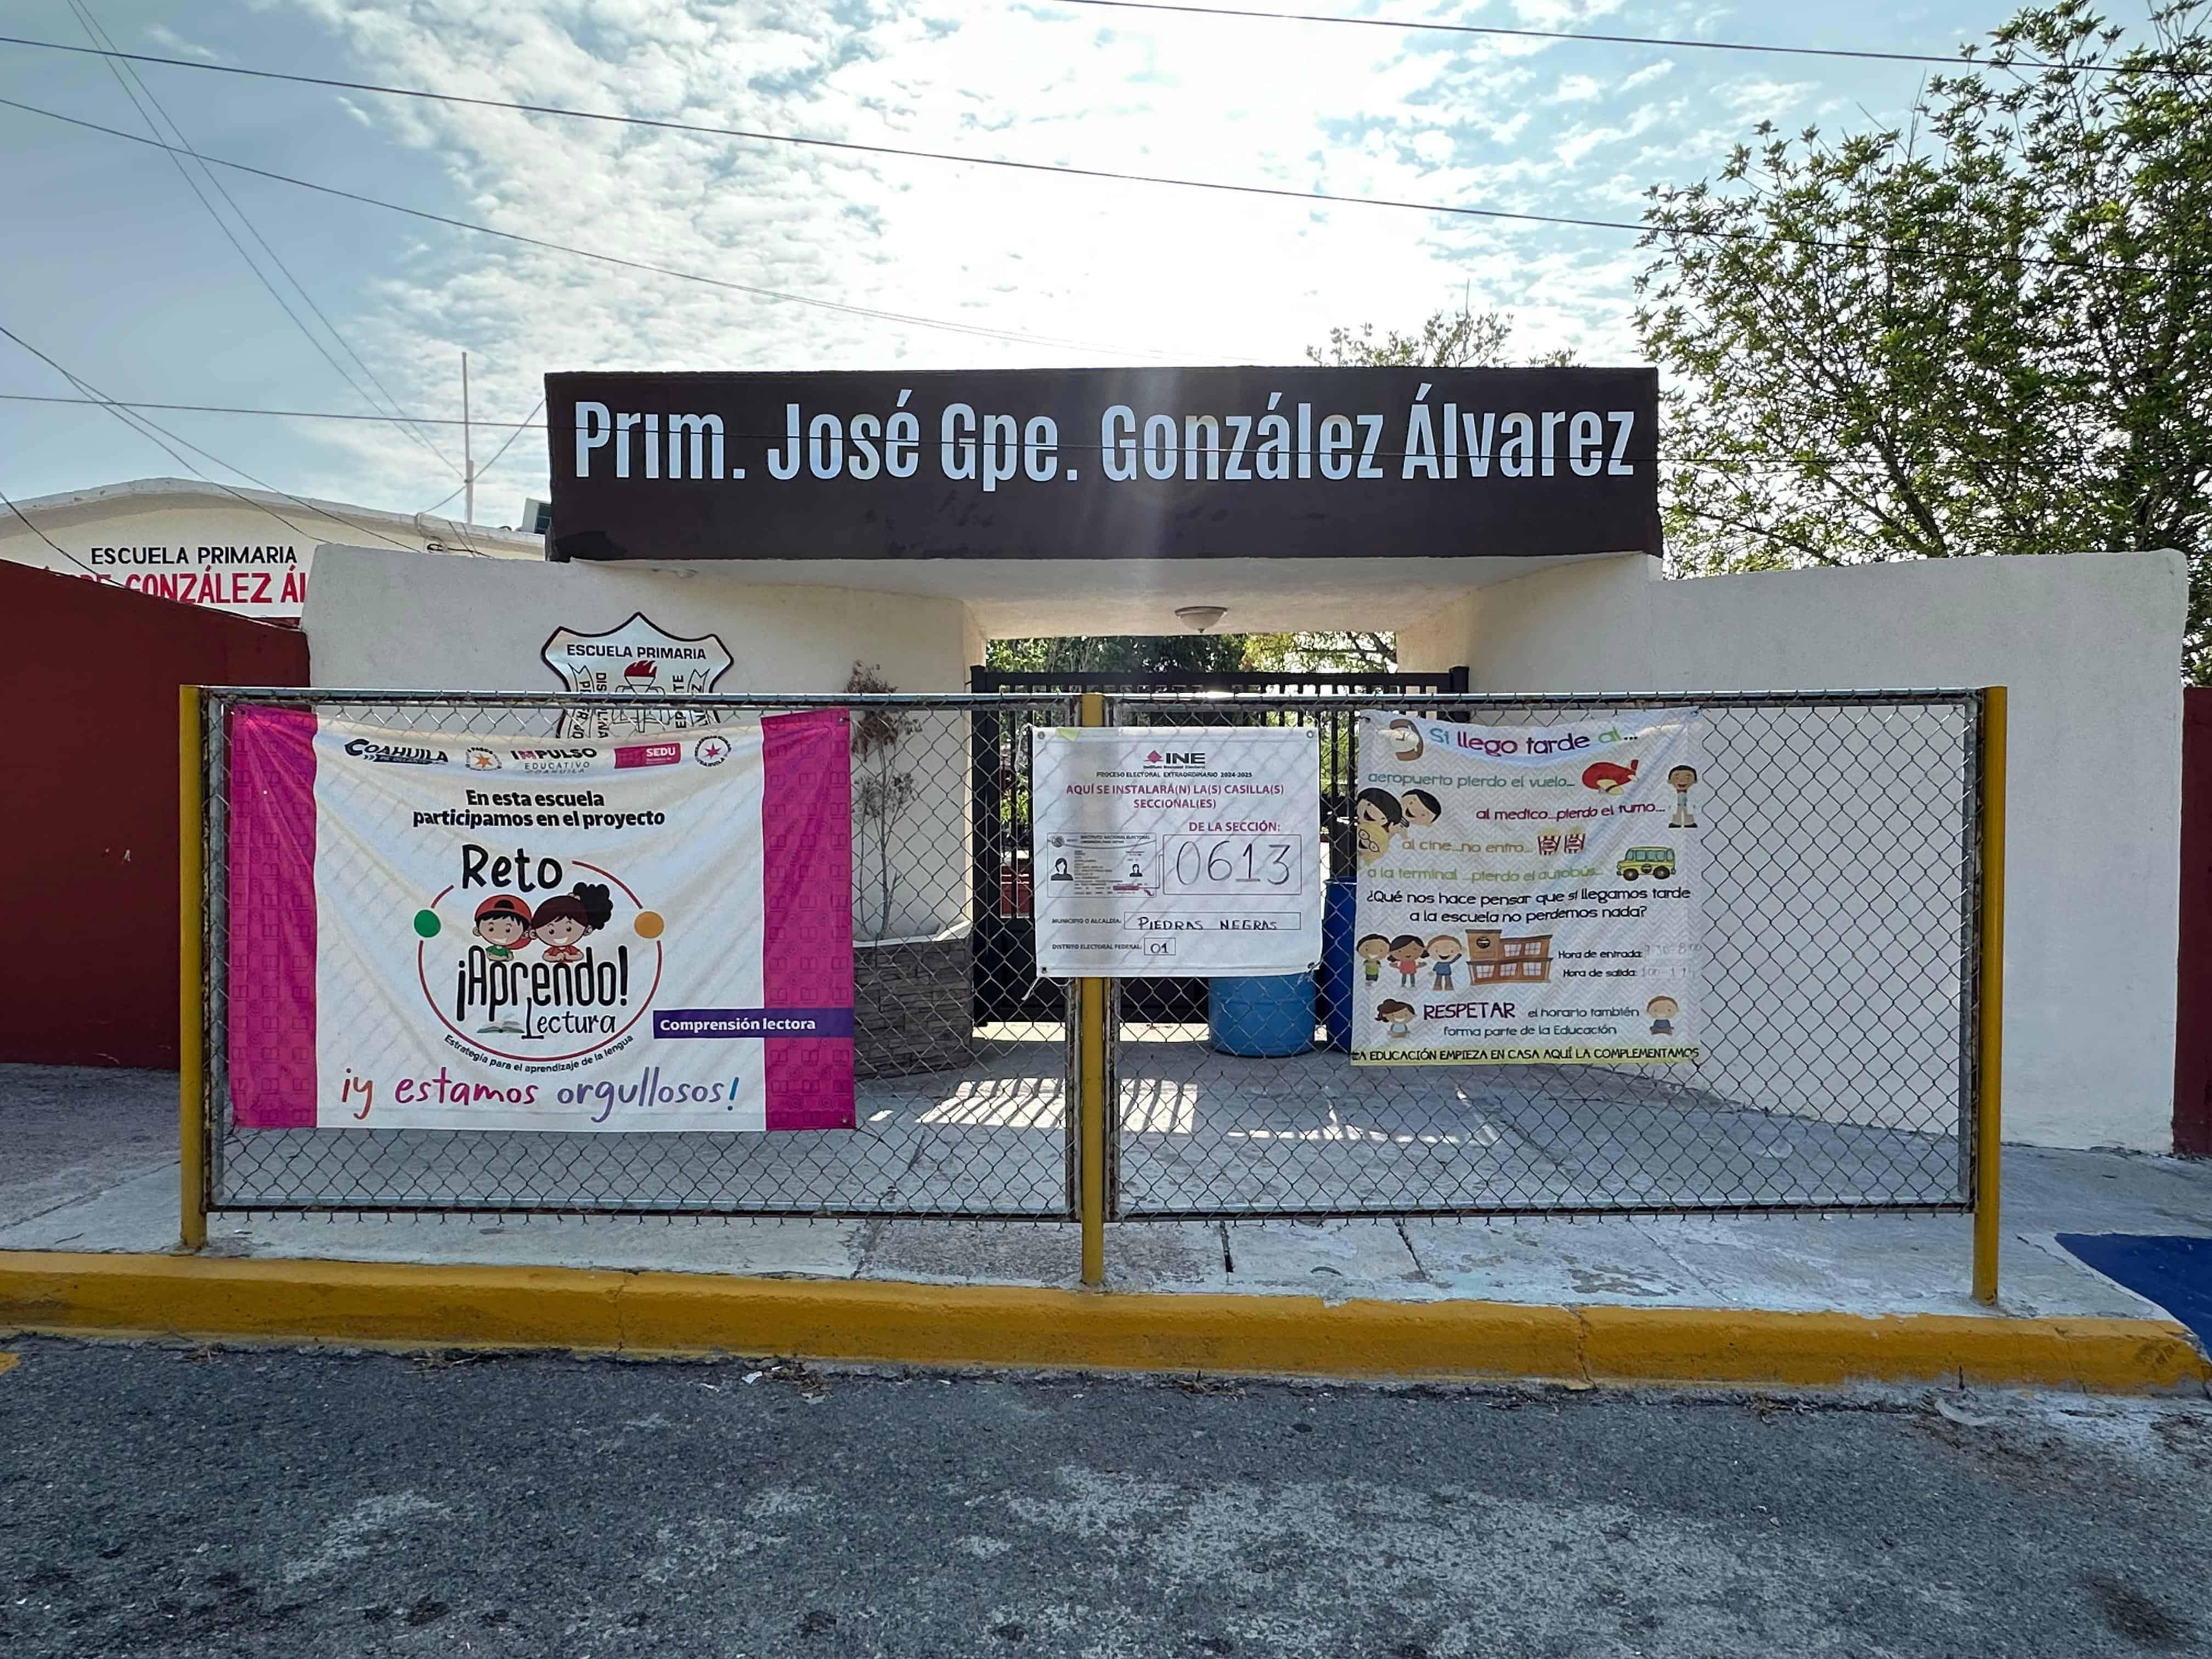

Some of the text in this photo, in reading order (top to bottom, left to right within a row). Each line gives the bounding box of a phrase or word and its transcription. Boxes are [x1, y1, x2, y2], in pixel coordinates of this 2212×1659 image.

[574, 383, 1634, 492] Prim. José Gpe. González Álvarez
[91, 545, 297, 564] ESCUELA PRIMARIA
[567, 644, 707, 659] ESCUELA PRIMARIA
[344, 738, 448, 763] COAHUILA
[646, 747, 676, 757] SEDU
[1457, 731, 1518, 757] llego
[1526, 733, 1590, 754] tarde
[511, 748, 597, 760] IMPULSO
[1166, 753, 1205, 764] INE
[1368, 772, 1453, 786] aeropuerto
[1457, 775, 1506, 788] pierdo
[1511, 776, 1524, 788] el
[1066, 783, 1284, 795] AQUÍ SE INSTALARÁ(N) LA(S) CASILLA(S)
[465, 789, 605, 806] En esta escuela
[1133, 799, 1216, 810] SECCIONAL(ES)
[413, 809, 665, 830] participamos en el proyecto
[1476, 808, 1489, 820] al
[1601, 805, 1614, 816] el
[1189, 820, 1281, 832] DE LA SECCIÓN:
[1402, 838, 1415, 850] al
[461, 844, 563, 893] Reto
[1176, 840, 1290, 885] 0613
[1367, 868, 1376, 878] a
[1380, 867, 1394, 878] la
[1399, 868, 1457, 881] terminal
[1523, 870, 1536, 882] el
[1366, 890, 1403, 903] ¿Qué
[1407, 894, 1435, 903] nos
[1438, 892, 1476, 904] hace
[1480, 895, 1532, 908] pensar
[1536, 893, 1565, 905] que
[1581, 888, 1647, 904] llegamos
[1652, 887, 1691, 899] tarde
[1410, 905, 1647, 924] a la escuela no perdemos nada?
[1137, 916, 1278, 930] PIEDRAS NEGRAS
[1150, 943, 1168, 953] 01
[1558, 950, 1582, 959] Hora
[1584, 950, 1597, 958] de
[1564, 969, 1586, 977] Hora
[1589, 968, 1603, 977] de
[456, 945, 628, 1022] ¡Aprendo!
[521, 997, 616, 1040] Lectura
[1424, 1002, 1639, 1020] RESPETAR el horario también
[659, 1017, 816, 1033] Comprensión lectora
[1444, 1024, 1617, 1039] forma parte de la Educación
[444, 1034, 634, 1074] Estrategia para el aprendizaje de la lengua
[1370, 1048, 1436, 1060] EDUCACIÓN
[1440, 1050, 1487, 1060] EMPIEZA
[1491, 1049, 1504, 1059] EN
[1508, 1049, 1539, 1059] CASA
[1543, 1047, 1573, 1059] AQUÍ
[1576, 1048, 1591, 1059] LA
[1594, 1047, 1699, 1059] COMPLEMENTAMOS
[395, 1066, 539, 1106] estamos
[557, 1066, 740, 1124] orgullosos!
